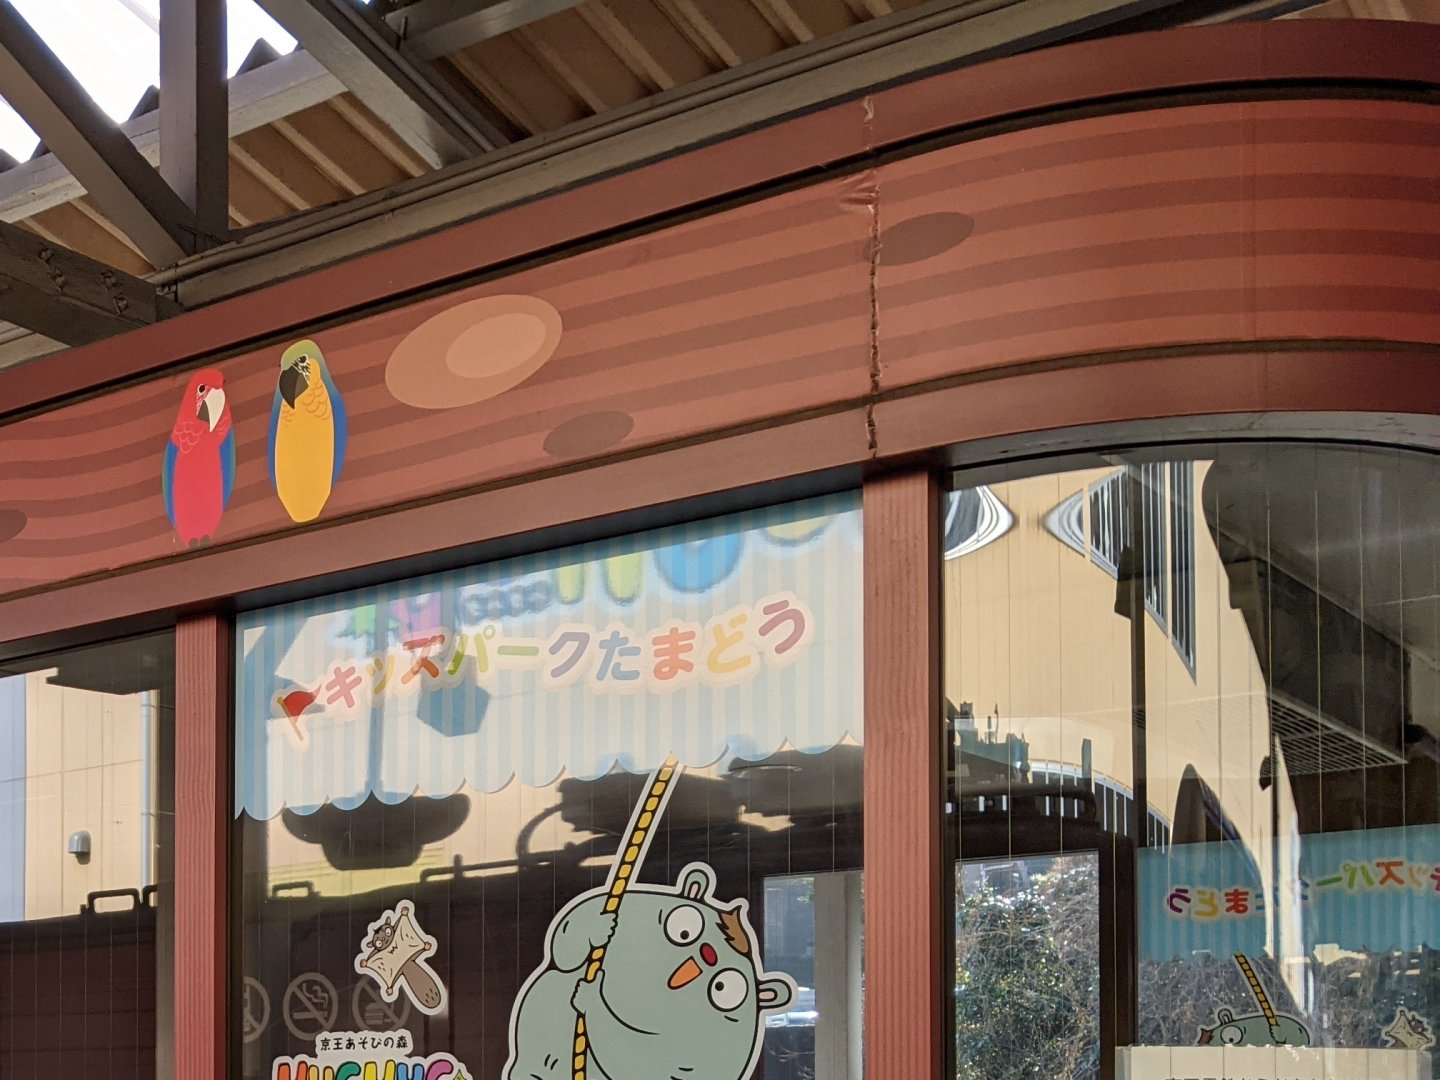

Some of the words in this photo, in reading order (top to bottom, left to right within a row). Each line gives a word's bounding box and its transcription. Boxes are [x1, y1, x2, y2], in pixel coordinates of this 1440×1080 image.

[324, 599, 808, 710] キッズパークたまどう
[320, 1034, 408, 1051] 京王あそびの森
